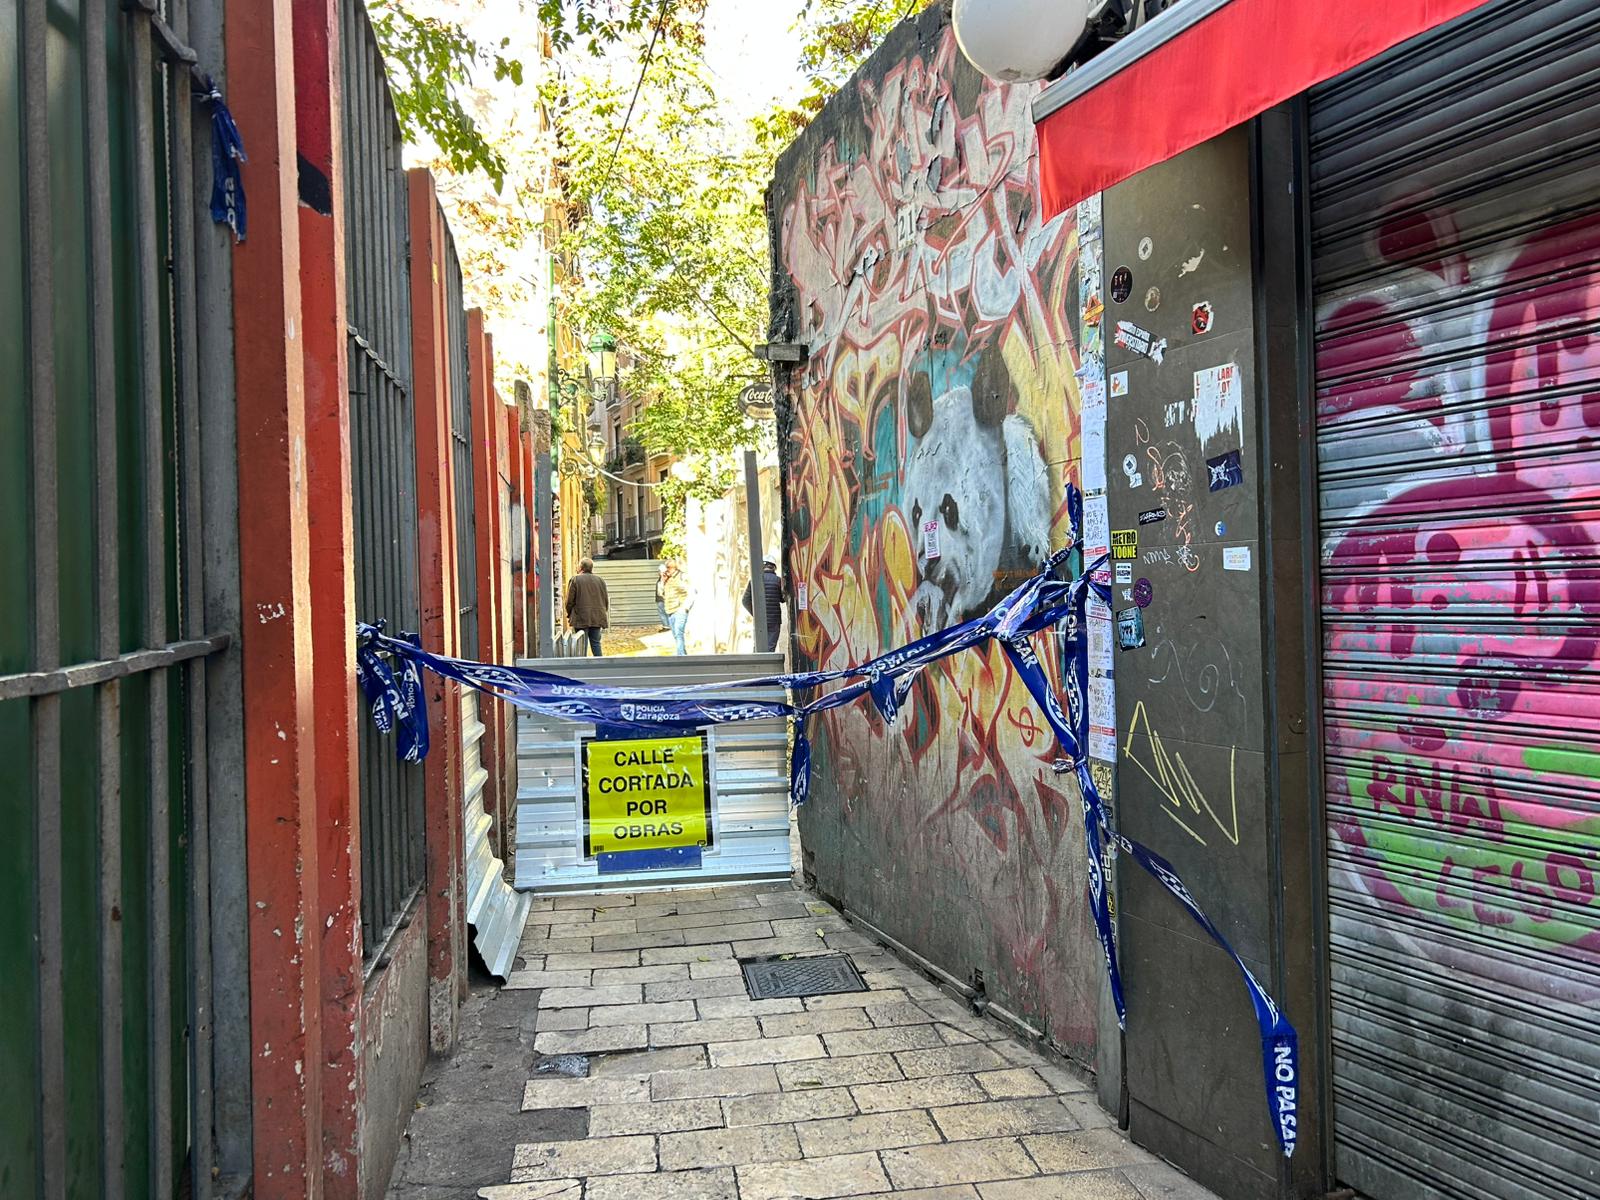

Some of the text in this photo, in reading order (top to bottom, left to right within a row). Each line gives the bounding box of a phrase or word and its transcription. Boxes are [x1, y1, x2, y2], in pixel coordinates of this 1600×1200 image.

[899, 211, 914, 241] 21
[1112, 531, 1136, 544] METRO
[636, 711, 680, 723] Zaragoza
[614, 749, 674, 767] CALLE
[598, 773, 694, 794] CORTADA
[626, 799, 667, 816] POR
[614, 822, 683, 840] OBRAS
[1274, 1046, 1297, 1158] NO PASAR
